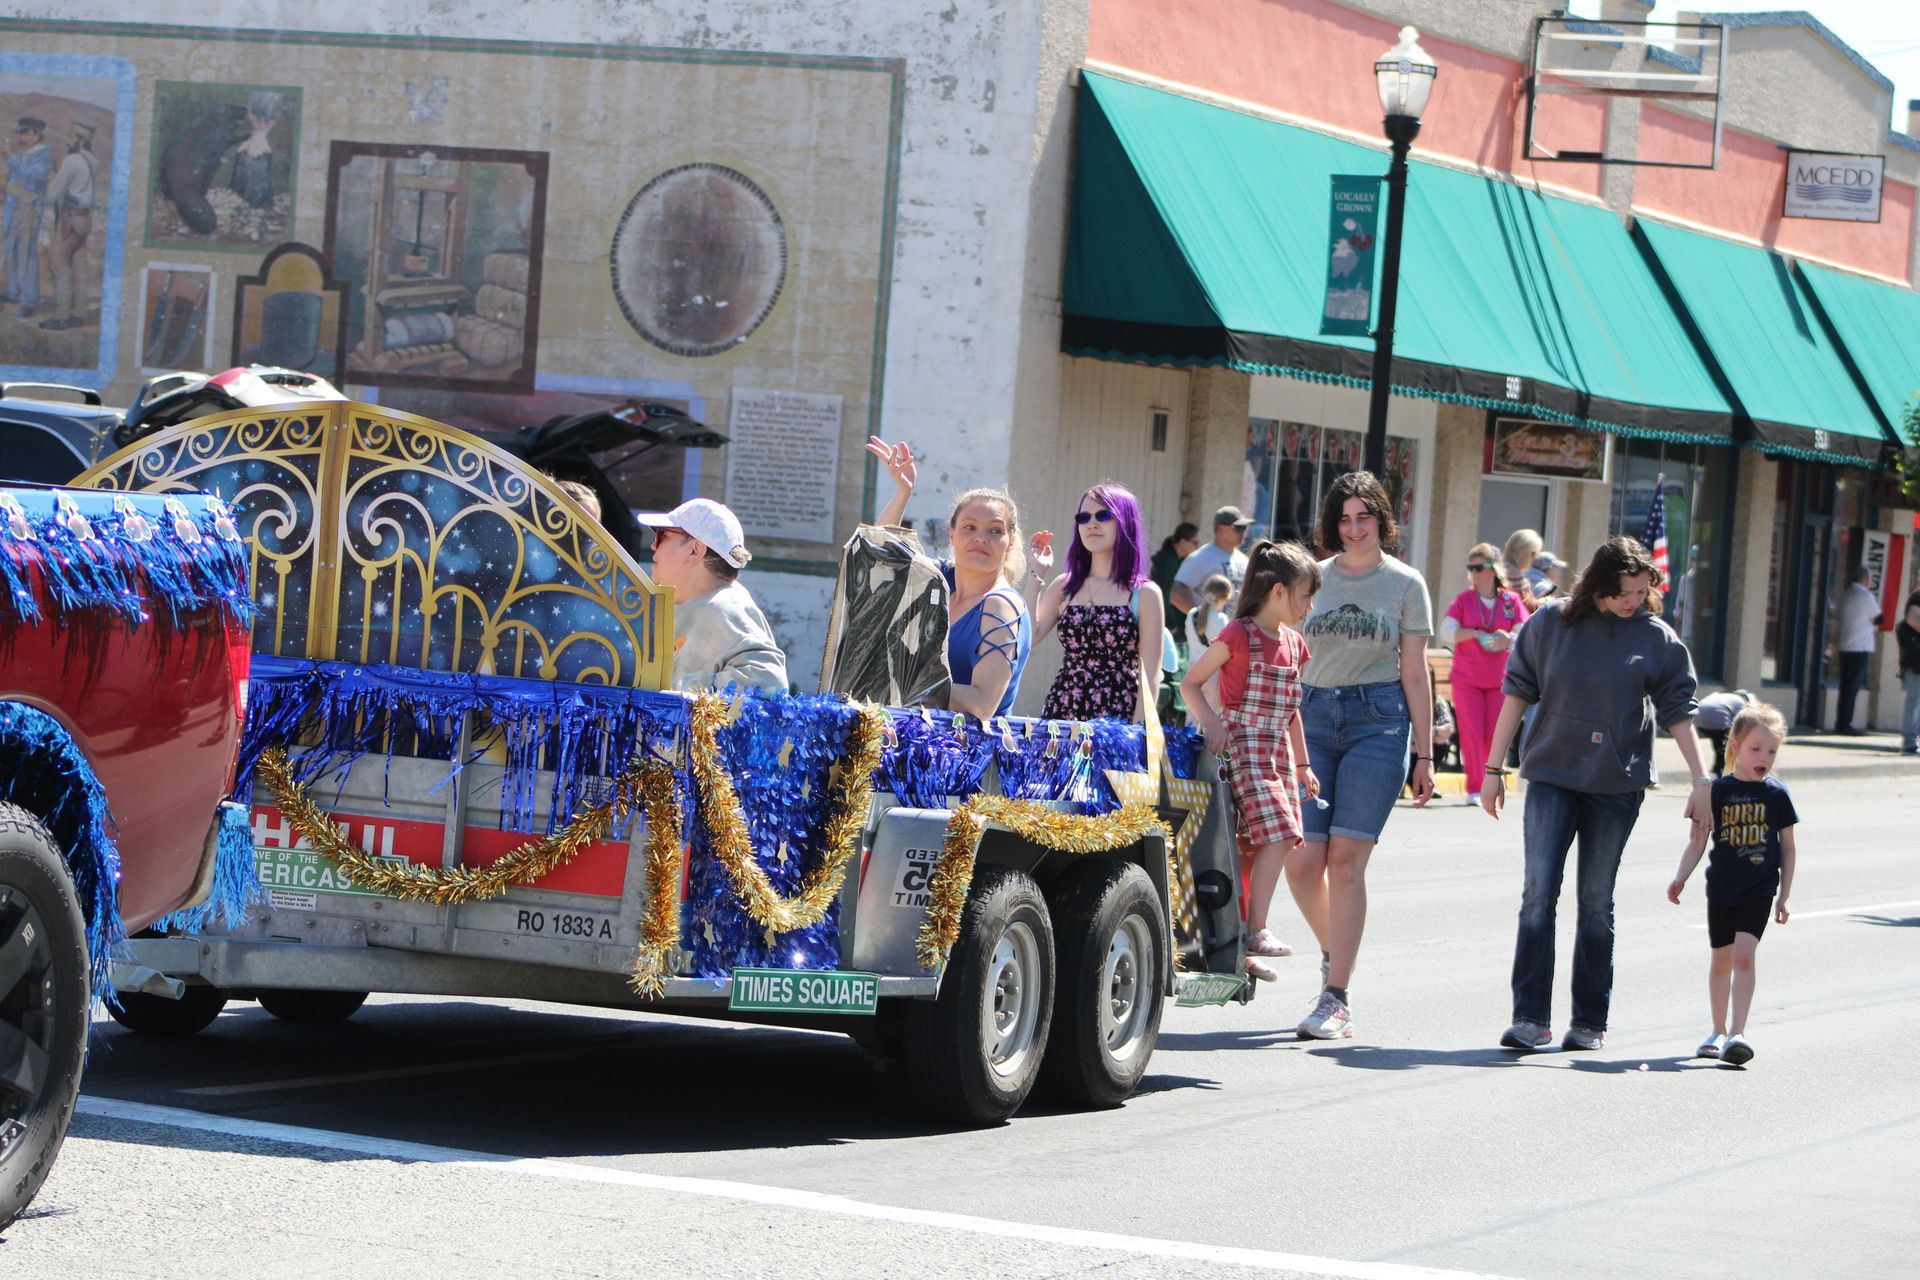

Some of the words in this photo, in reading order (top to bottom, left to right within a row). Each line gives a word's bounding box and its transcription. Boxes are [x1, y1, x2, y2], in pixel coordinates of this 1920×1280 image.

[1796, 165, 1874, 187] MCEDD
[1334, 191, 1376, 202] LOCALLY
[1336, 202, 1373, 213] GROWN
[278, 852, 292, 862] OF
[299, 854, 318, 864] THE
[254, 862, 351, 889] ERICAS
[518, 910, 544, 932] RO
[553, 914, 594, 937] 1833
[599, 919, 612, 939] A
[737, 976, 793, 1003] TIMES
[798, 977, 875, 1006] SQUARE
